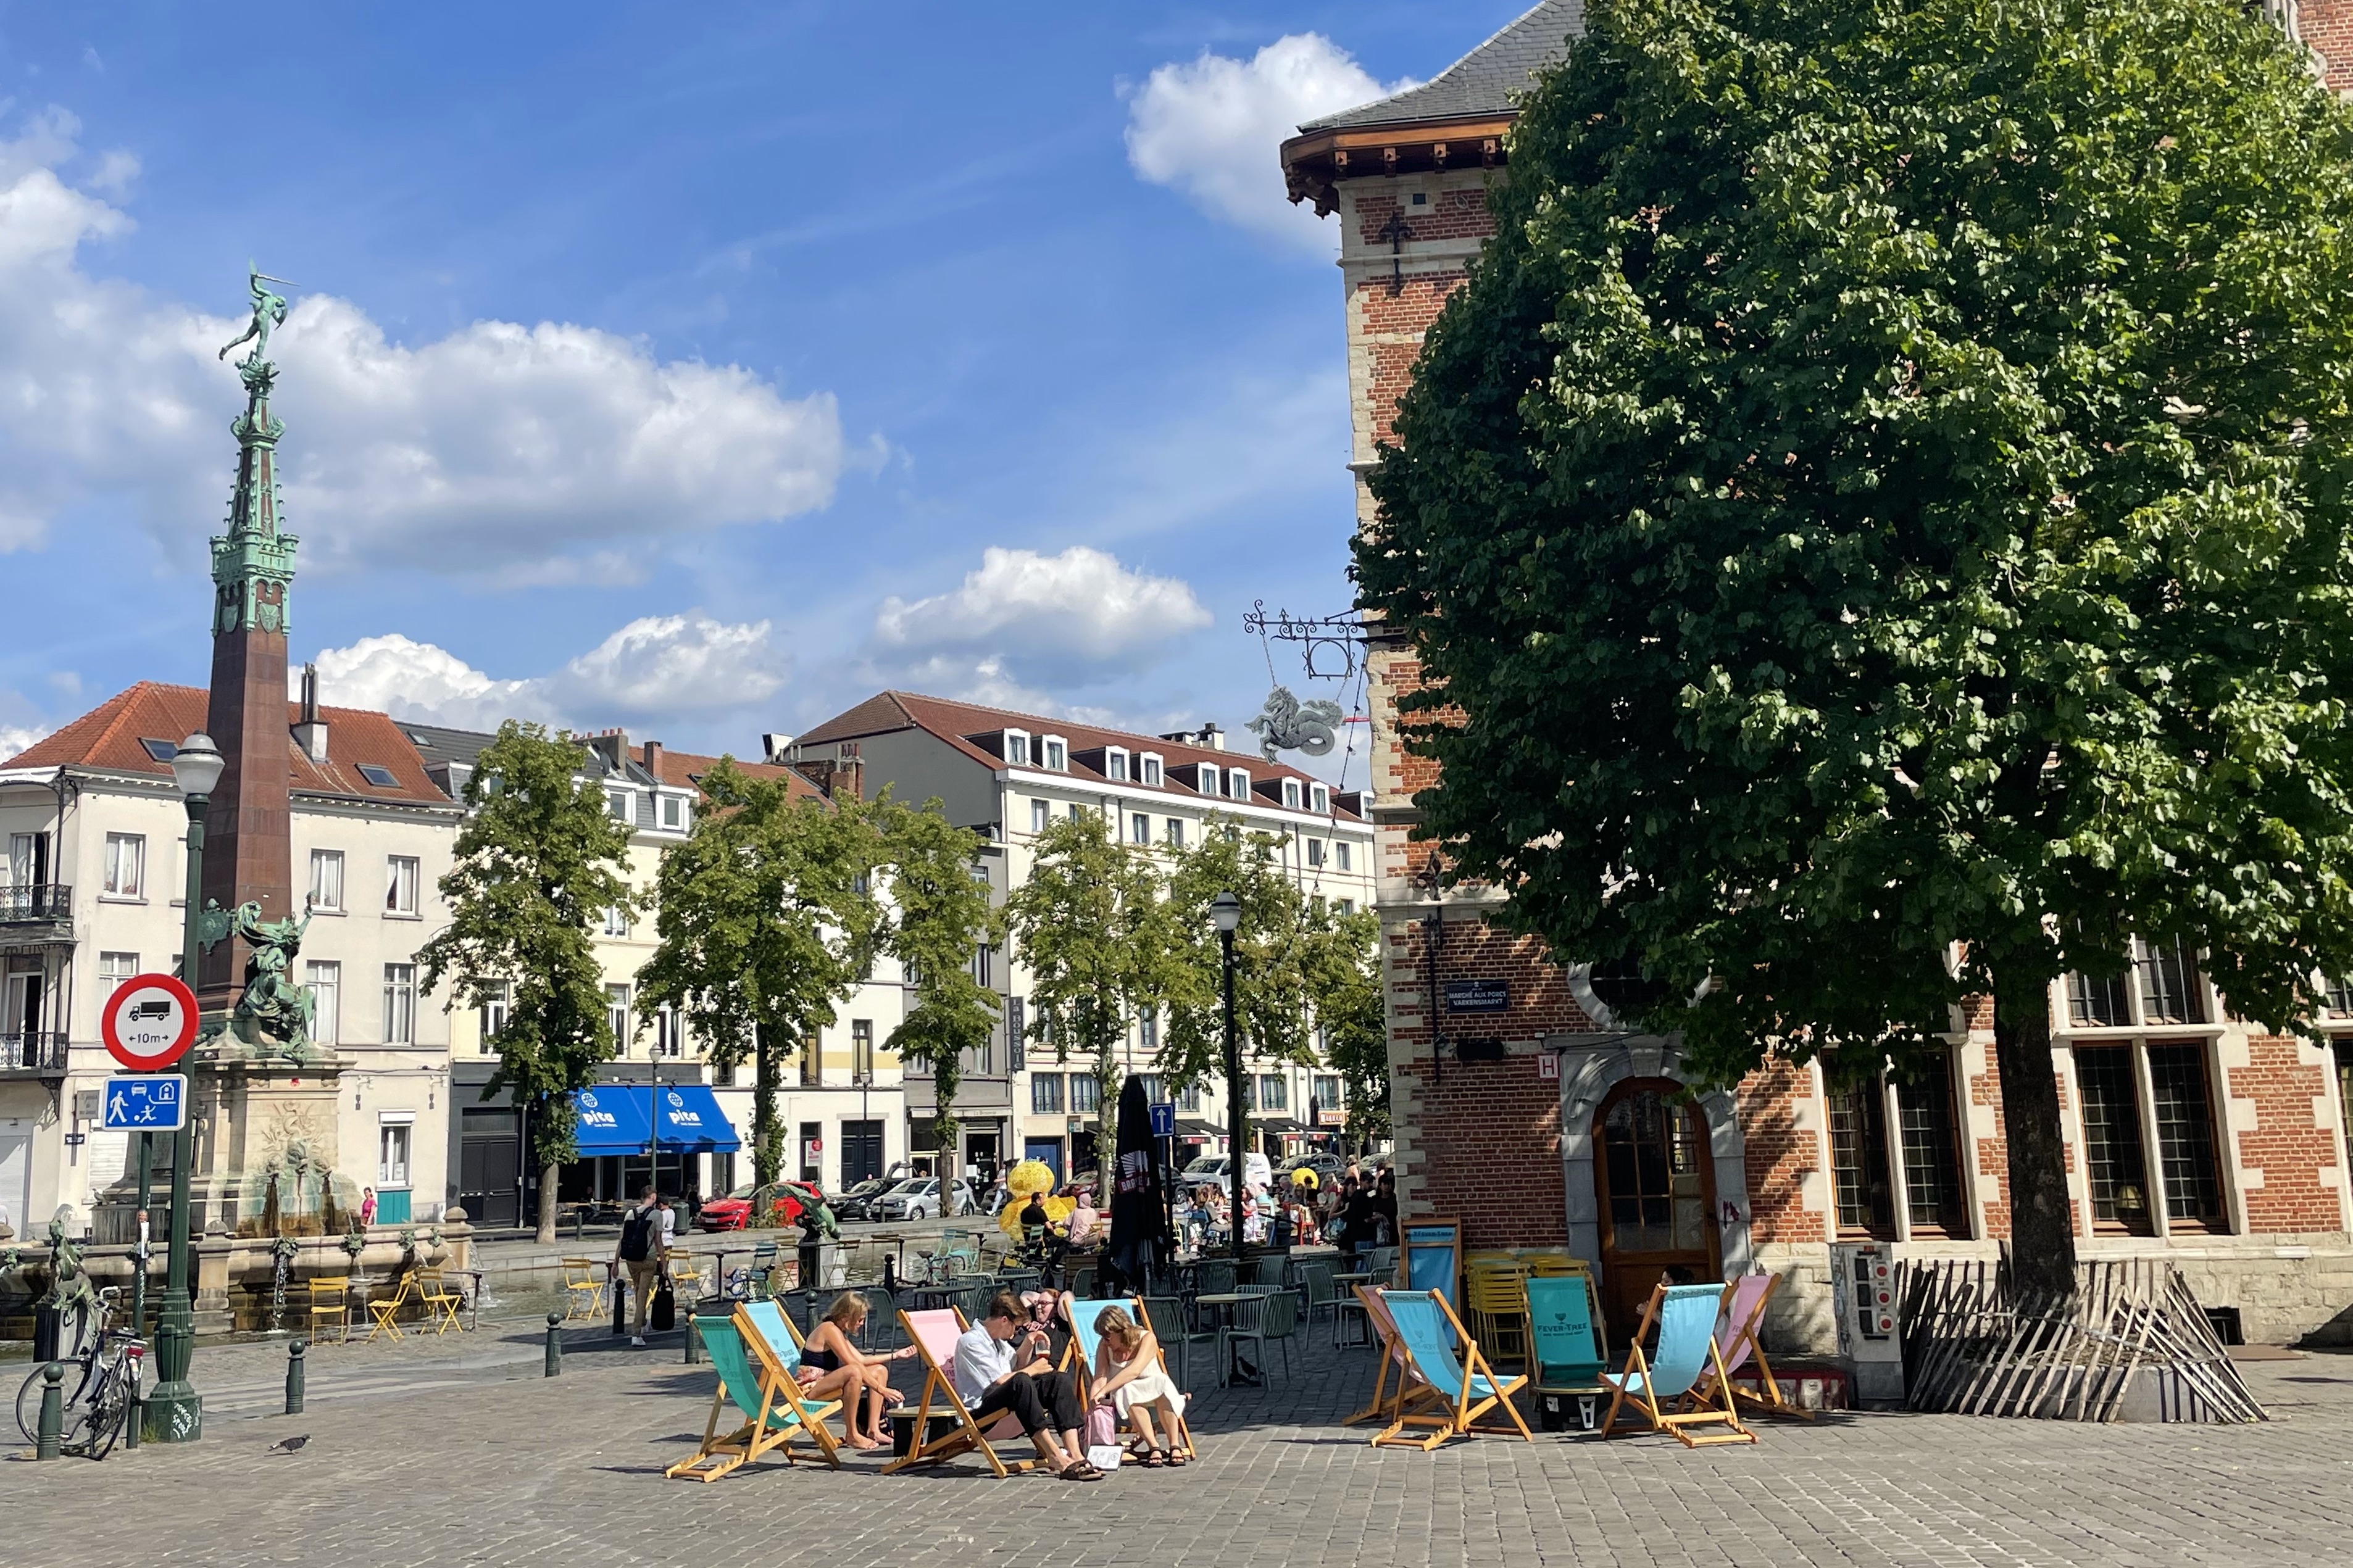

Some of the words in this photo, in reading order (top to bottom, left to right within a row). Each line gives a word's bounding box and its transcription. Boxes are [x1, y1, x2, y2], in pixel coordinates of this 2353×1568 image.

[1449, 990, 1473, 998] MARCHÉ
[1543, 1058, 1554, 1075] H
[583, 1110, 615, 1126] pita
[669, 1109, 701, 1124] pita
[1538, 1322, 1588, 1332] FEVER-TREE
